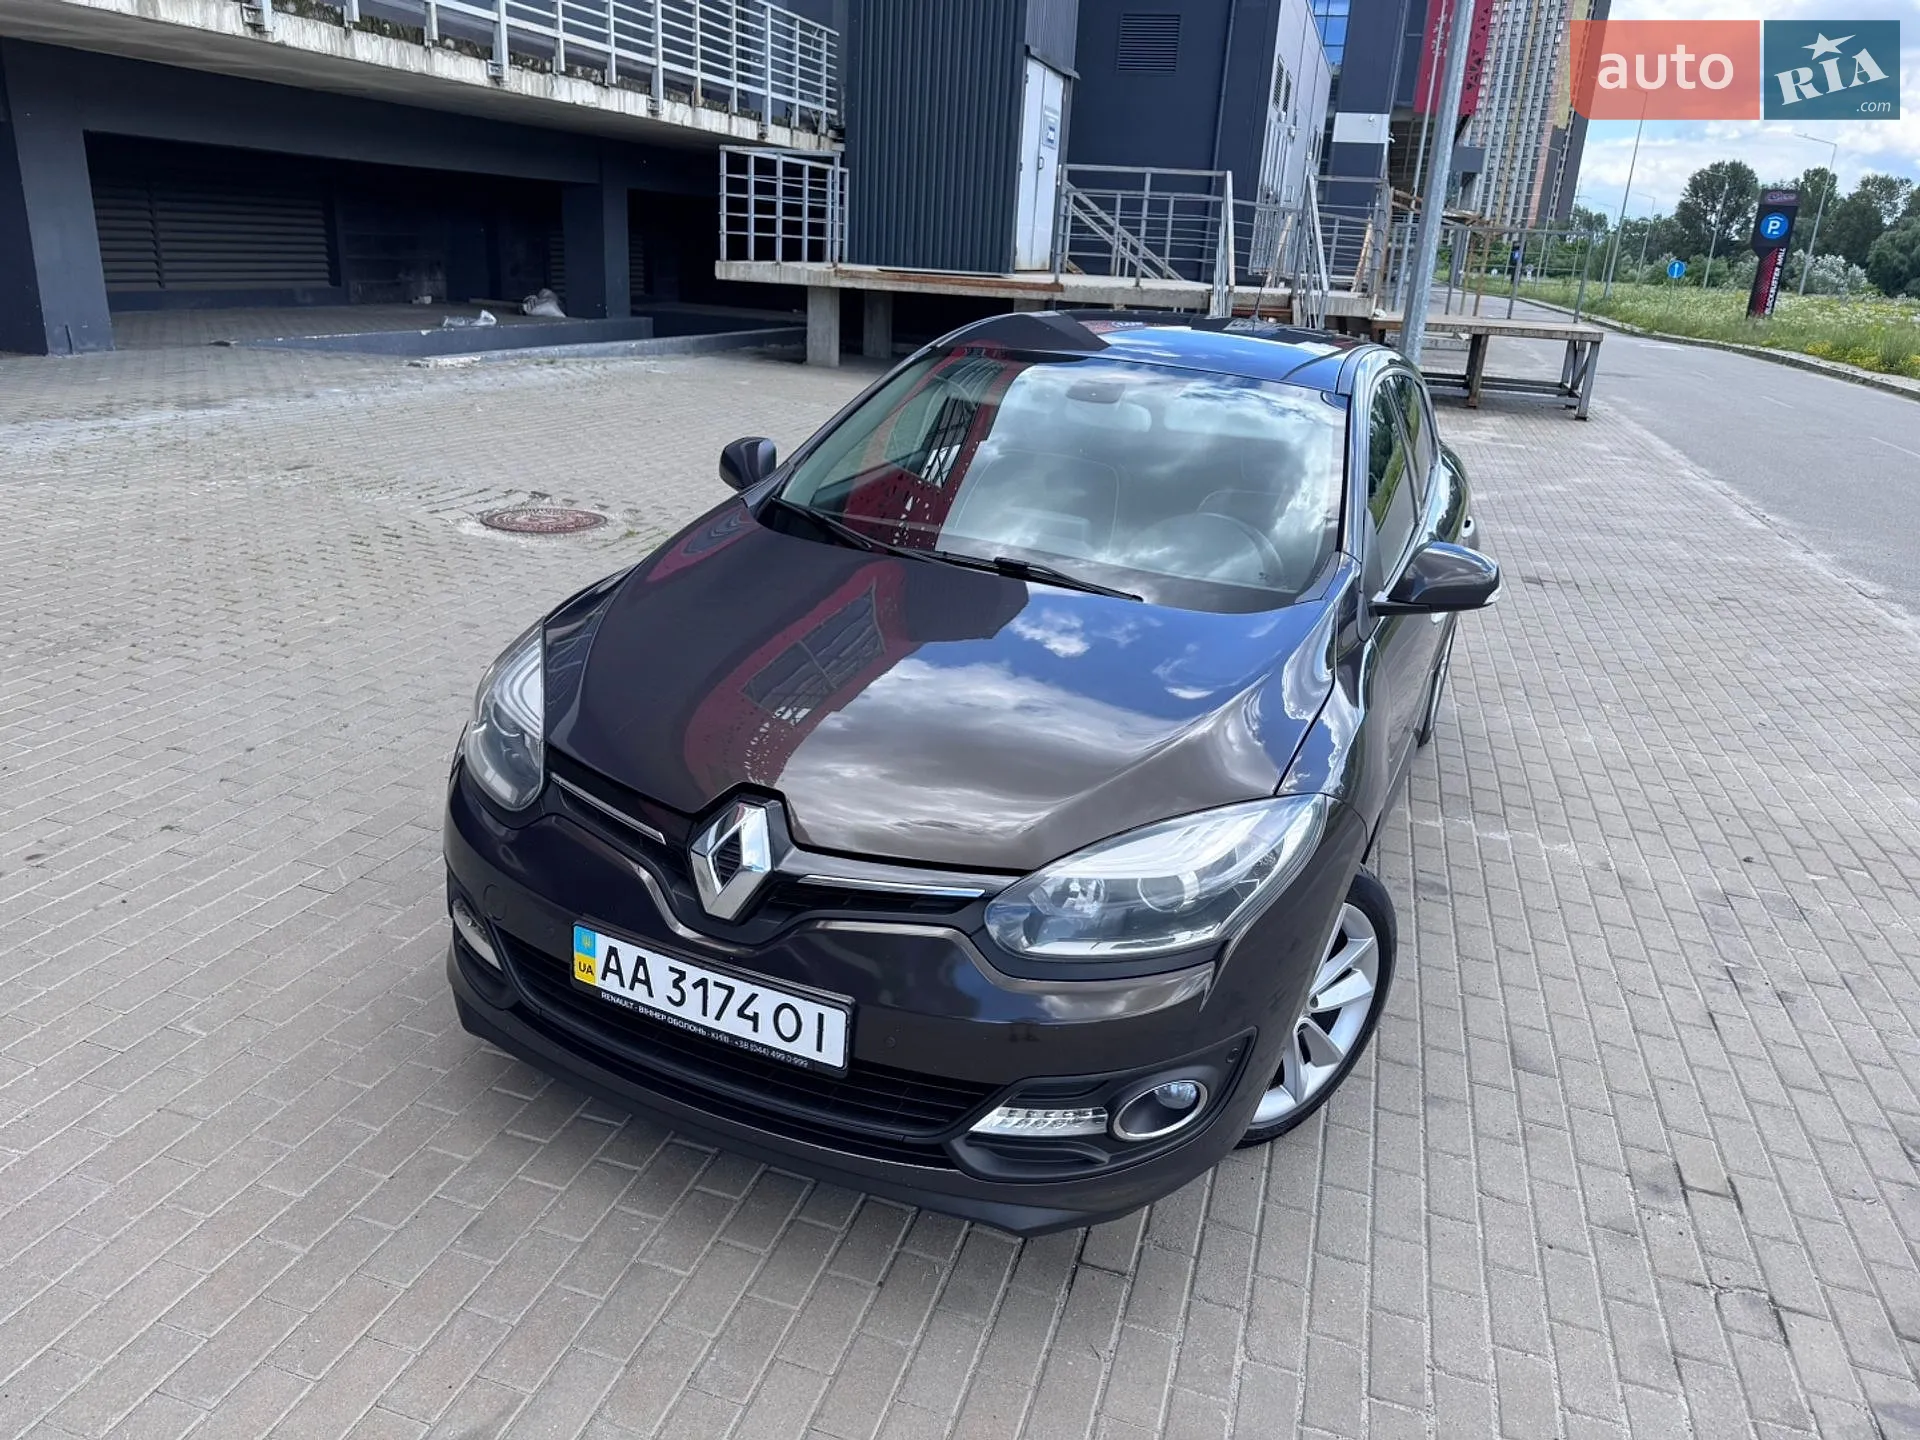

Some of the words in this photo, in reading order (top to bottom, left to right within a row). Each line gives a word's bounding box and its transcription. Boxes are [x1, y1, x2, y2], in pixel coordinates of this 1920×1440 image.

[1767, 219, 1781, 234] P
[1775, 247, 1787, 266] MALL
[578, 960, 595, 976] UA
[600, 945, 655, 998] AA
[666, 965, 760, 1033] 3174
[773, 1002, 825, 1053] OI
[601, 991, 634, 1010] RENAULT
